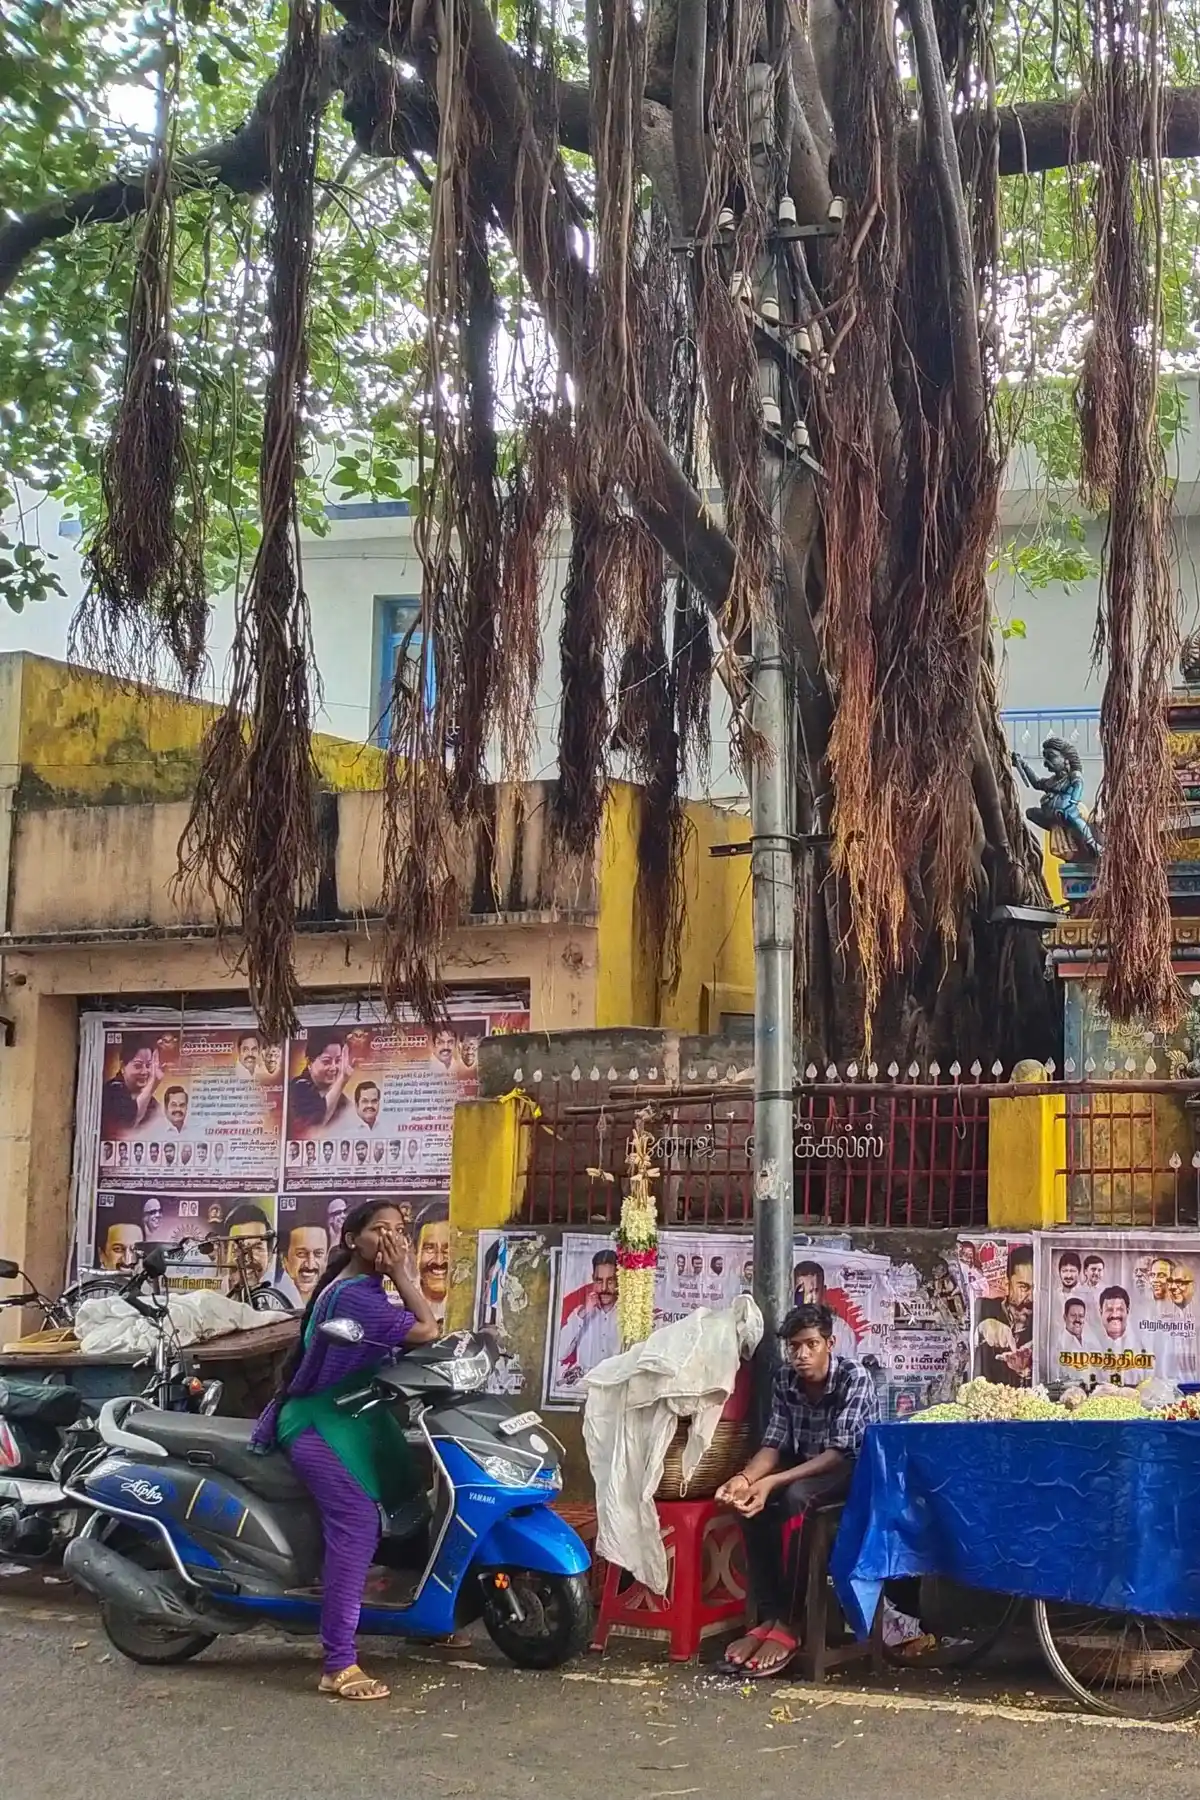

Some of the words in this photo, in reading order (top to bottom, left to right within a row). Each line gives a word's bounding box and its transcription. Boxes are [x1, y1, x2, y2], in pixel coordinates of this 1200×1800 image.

[1059, 1348, 1157, 1371] கழகத்தின்
[121, 1478, 163, 1505] Alpha
[468, 1491, 496, 1505] YAMAHA
